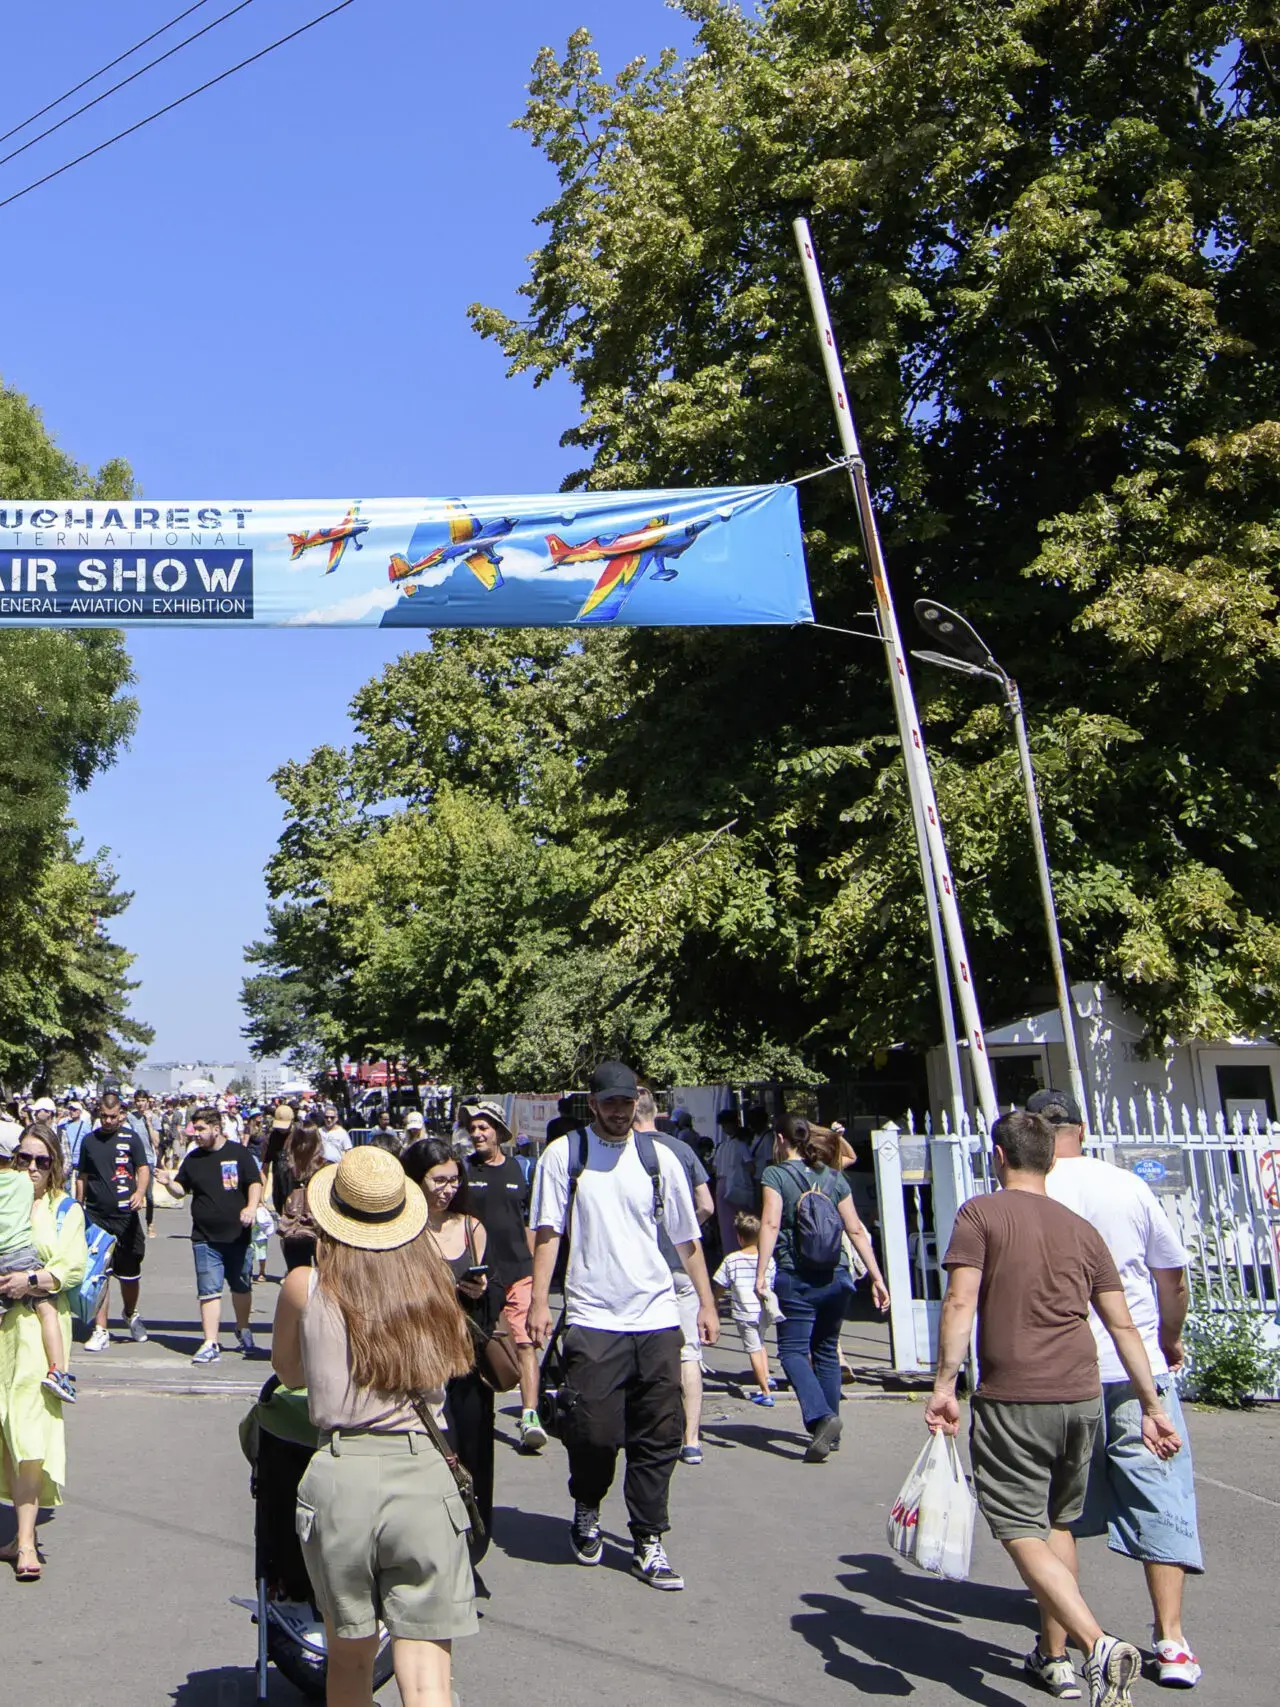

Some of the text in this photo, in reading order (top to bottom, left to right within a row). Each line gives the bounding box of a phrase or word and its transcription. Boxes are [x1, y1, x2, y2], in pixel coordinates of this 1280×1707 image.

[77, 558, 244, 593] SHOW
[70, 598, 143, 613] AVIATION
[152, 598, 246, 614] EXHIBITION
